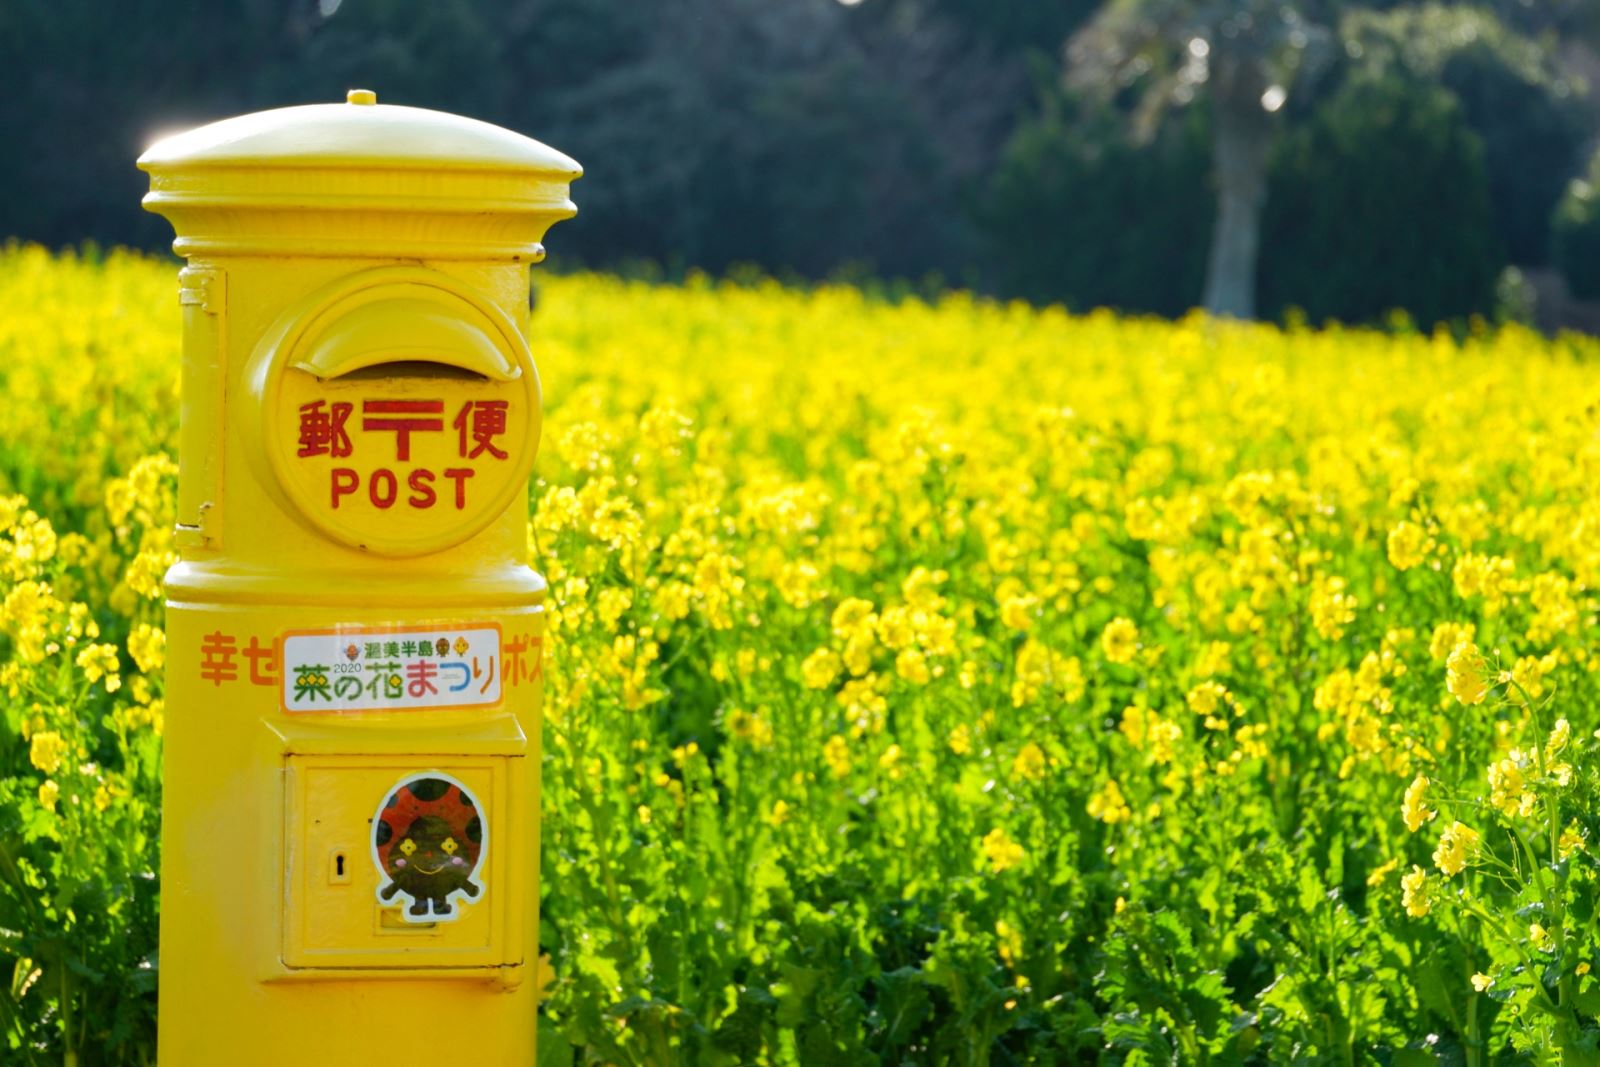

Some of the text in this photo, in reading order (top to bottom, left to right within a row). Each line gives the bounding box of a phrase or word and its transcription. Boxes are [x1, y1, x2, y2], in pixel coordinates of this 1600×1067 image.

[330, 468, 476, 509] POST
[200, 630, 280, 687] 幸せ
[333, 662, 363, 674] 2020
[364, 639, 433, 659] 渥美半島
[292, 655, 494, 703] 菜の花まつり
